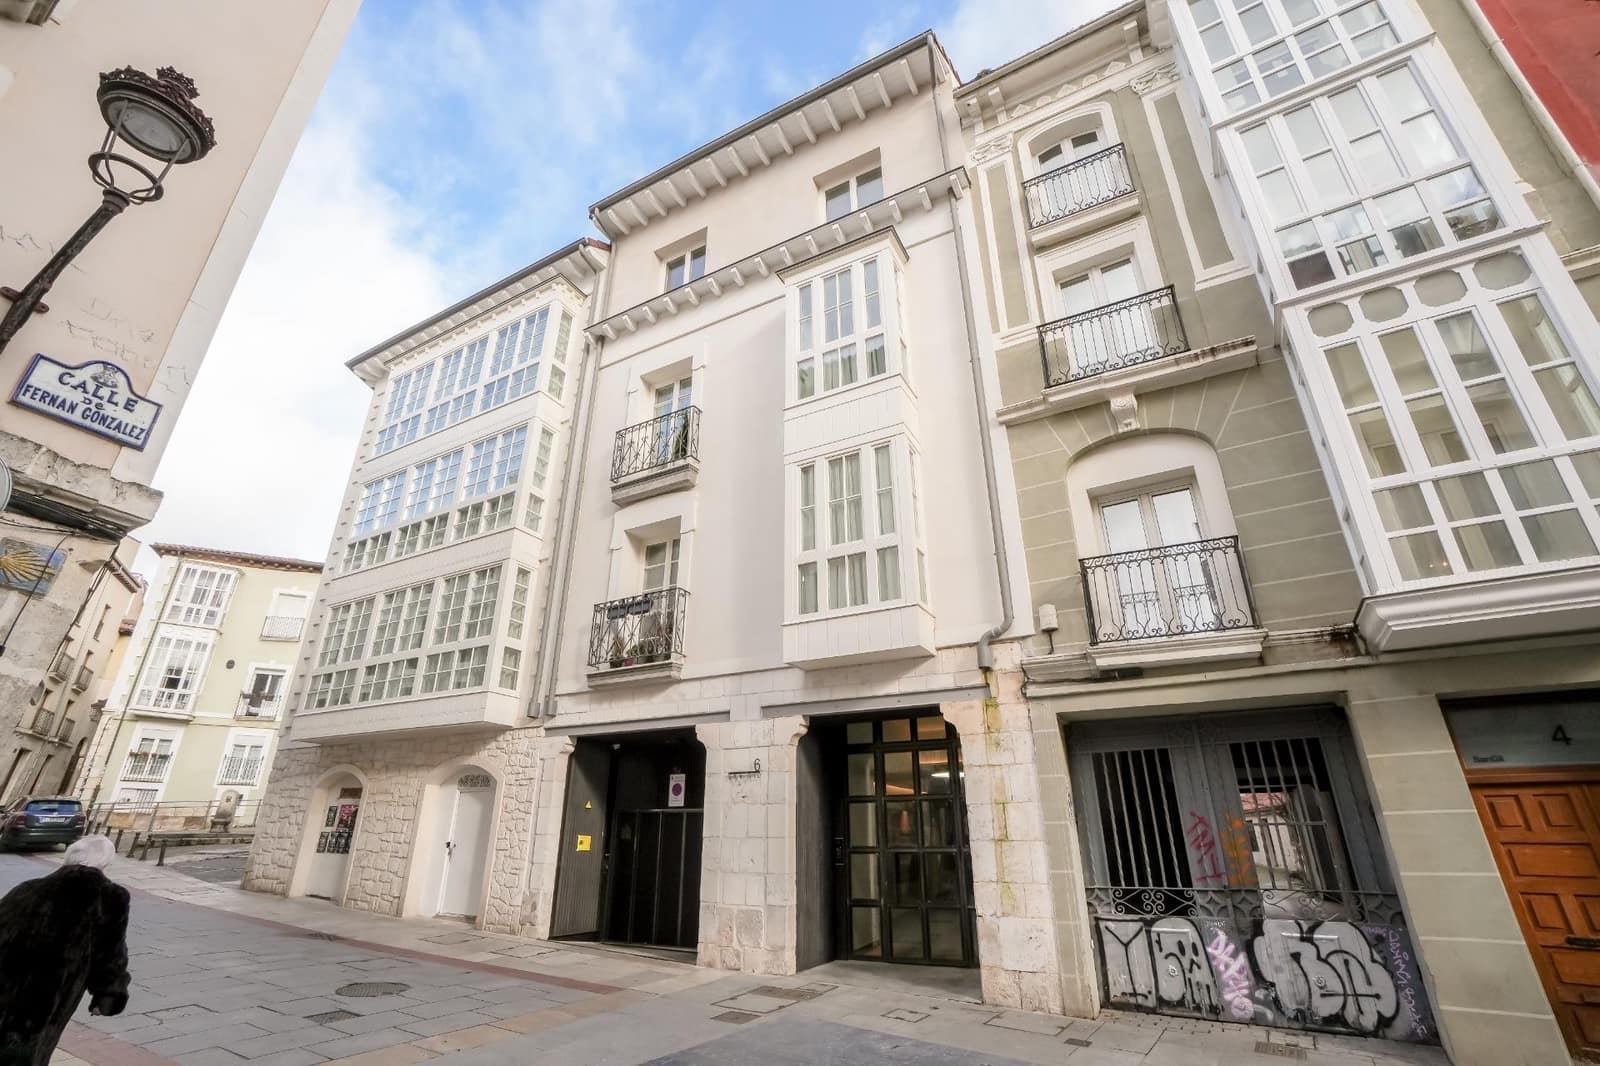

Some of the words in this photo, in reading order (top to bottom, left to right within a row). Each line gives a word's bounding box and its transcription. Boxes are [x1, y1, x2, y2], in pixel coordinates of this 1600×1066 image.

[58, 372, 139, 413] CALLE
[22, 384, 79, 415] FERNAN
[81, 407, 146, 441] GONZALEZ
[1552, 723, 1573, 745] 4
[753, 758, 761, 772] 6
